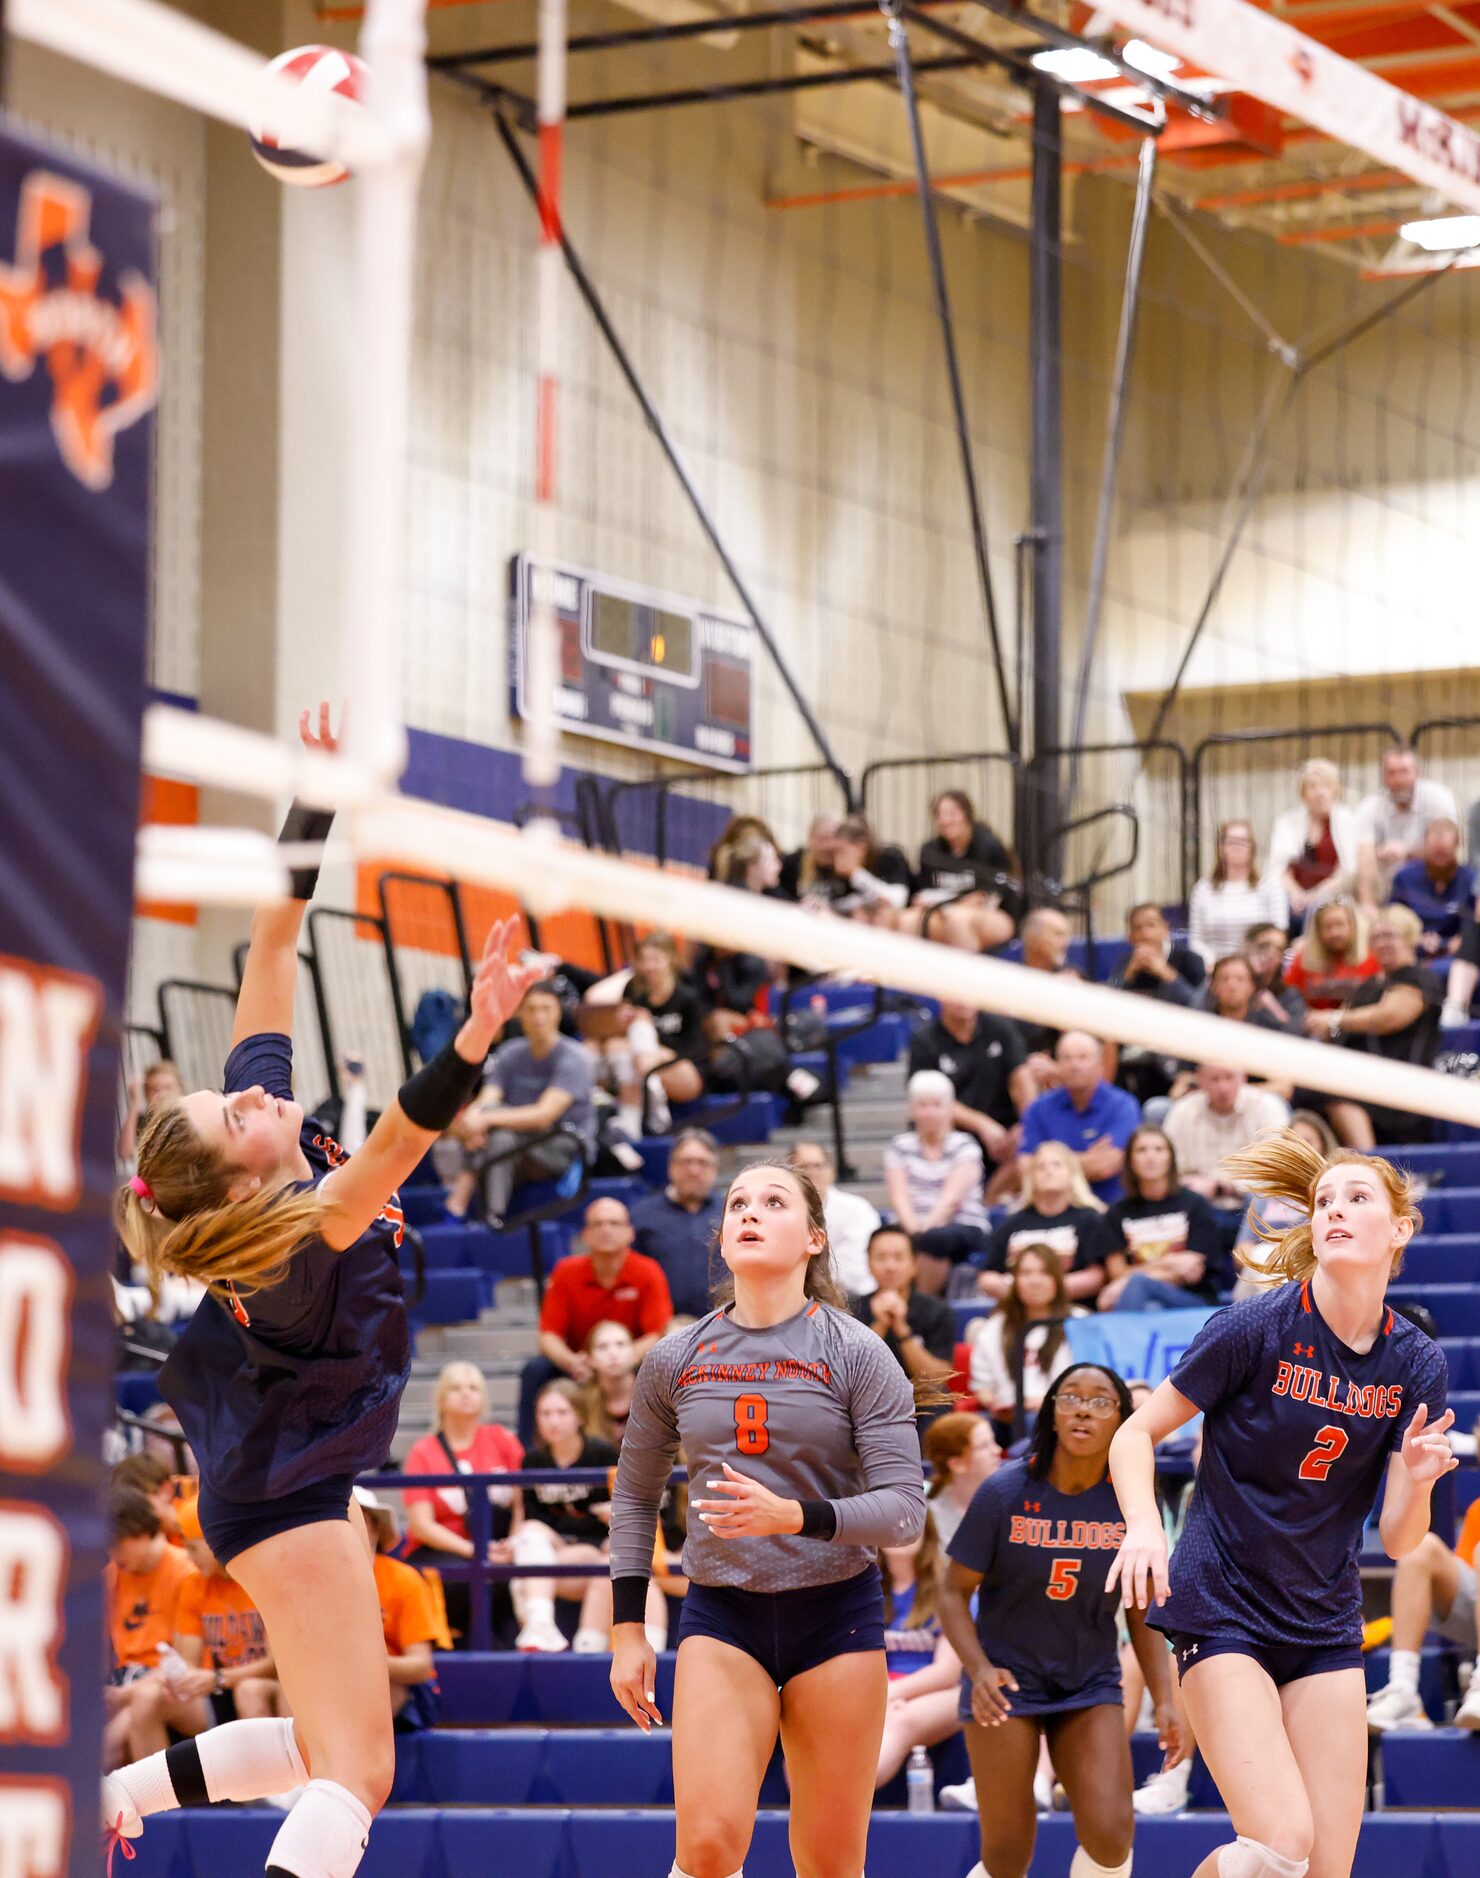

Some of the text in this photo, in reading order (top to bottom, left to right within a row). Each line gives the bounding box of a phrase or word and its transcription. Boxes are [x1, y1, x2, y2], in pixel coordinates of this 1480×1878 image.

[1271, 1359, 1404, 1419] BULLDOGS
[733, 1392, 770, 1456] 8
[1298, 1424, 1350, 1482] 2
[1008, 1514, 1127, 1550] BULLDOGS
[1045, 1557, 1083, 1601] 5
